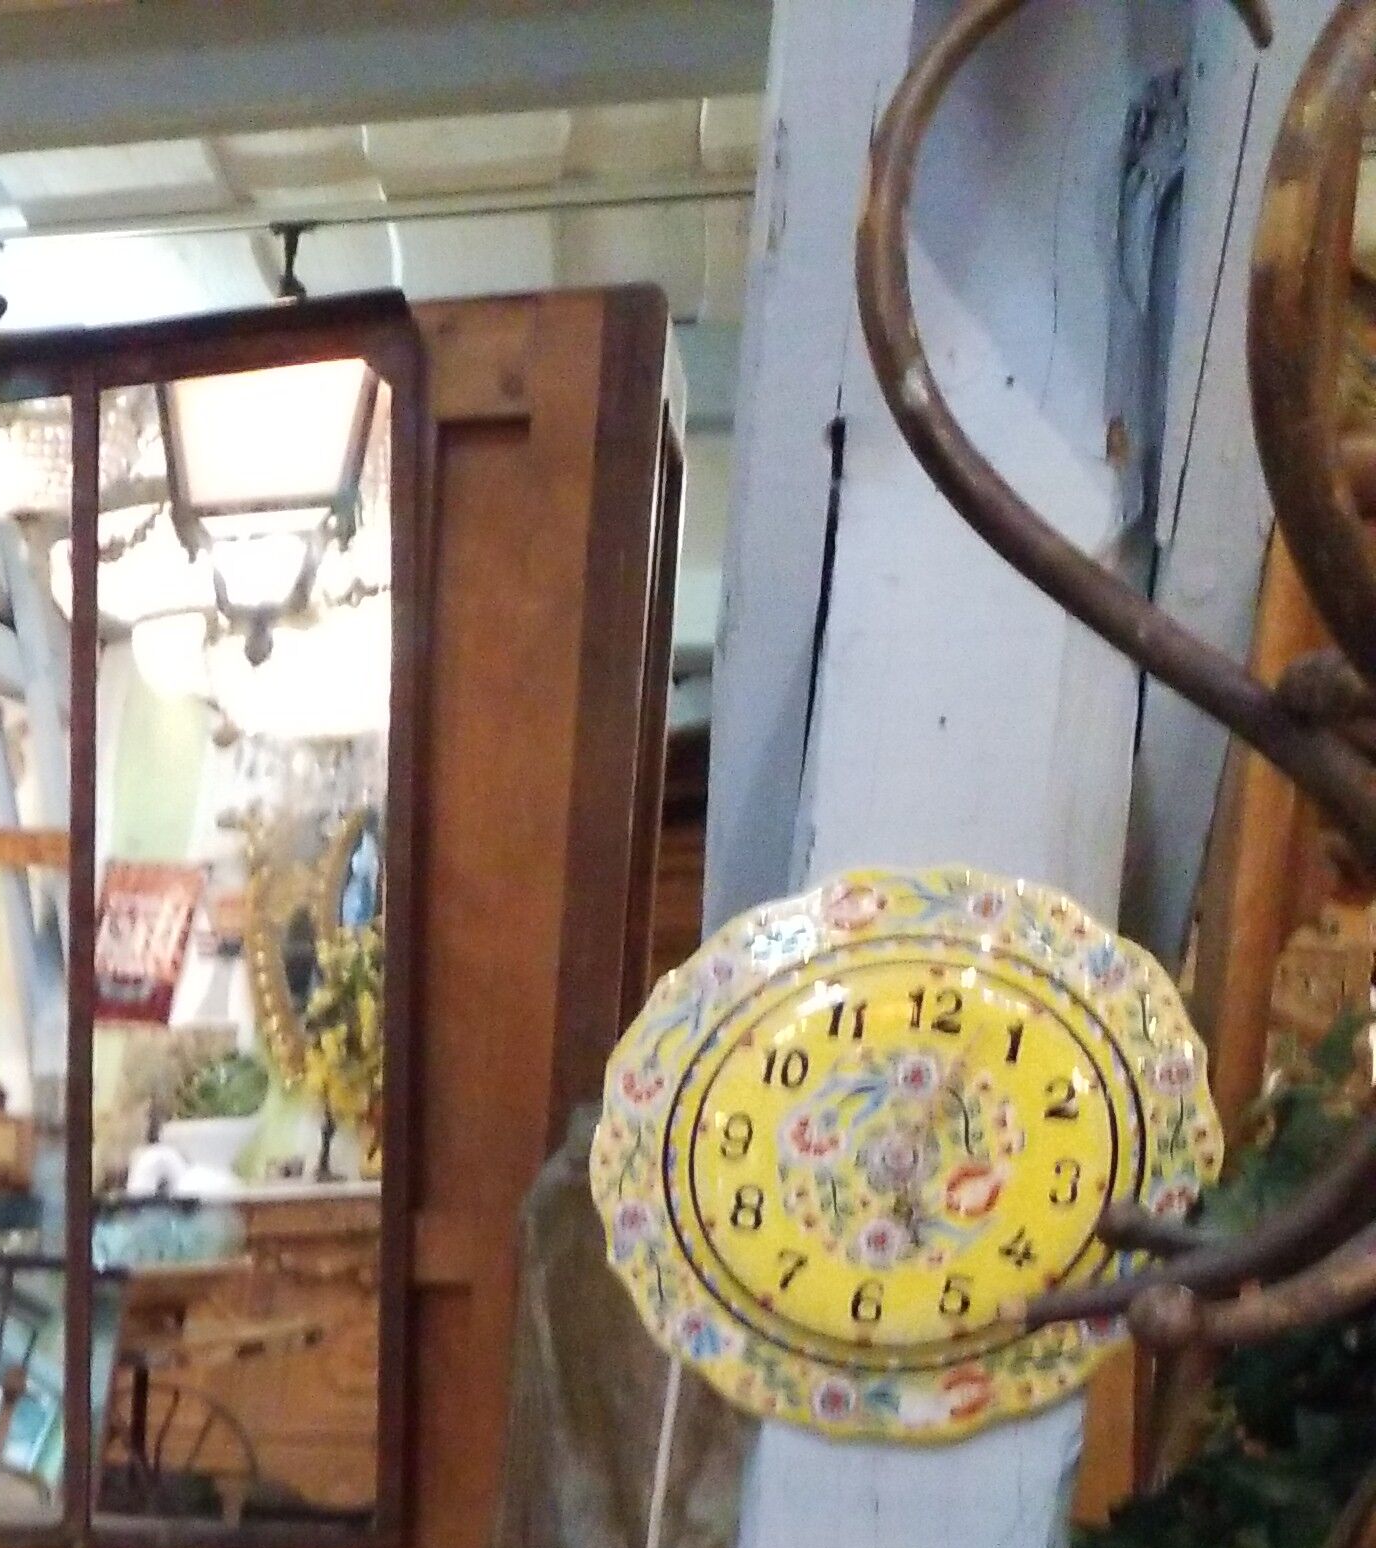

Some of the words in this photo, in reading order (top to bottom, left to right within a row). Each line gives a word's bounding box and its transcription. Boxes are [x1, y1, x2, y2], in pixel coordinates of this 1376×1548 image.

[826, 1000, 867, 1042] 11
[908, 986, 964, 1034] 12
[1004, 1021, 1024, 1064] 1
[761, 1048, 810, 1089] 10
[1043, 1076, 1080, 1122] 2
[720, 1112, 754, 1161] 9
[1048, 1158, 1081, 1206] 3
[729, 1185, 764, 1231] 8
[999, 1226, 1036, 1270] 4
[777, 1250, 809, 1290] 7
[851, 1281, 884, 1324] 6
[938, 1276, 971, 1317] 5
